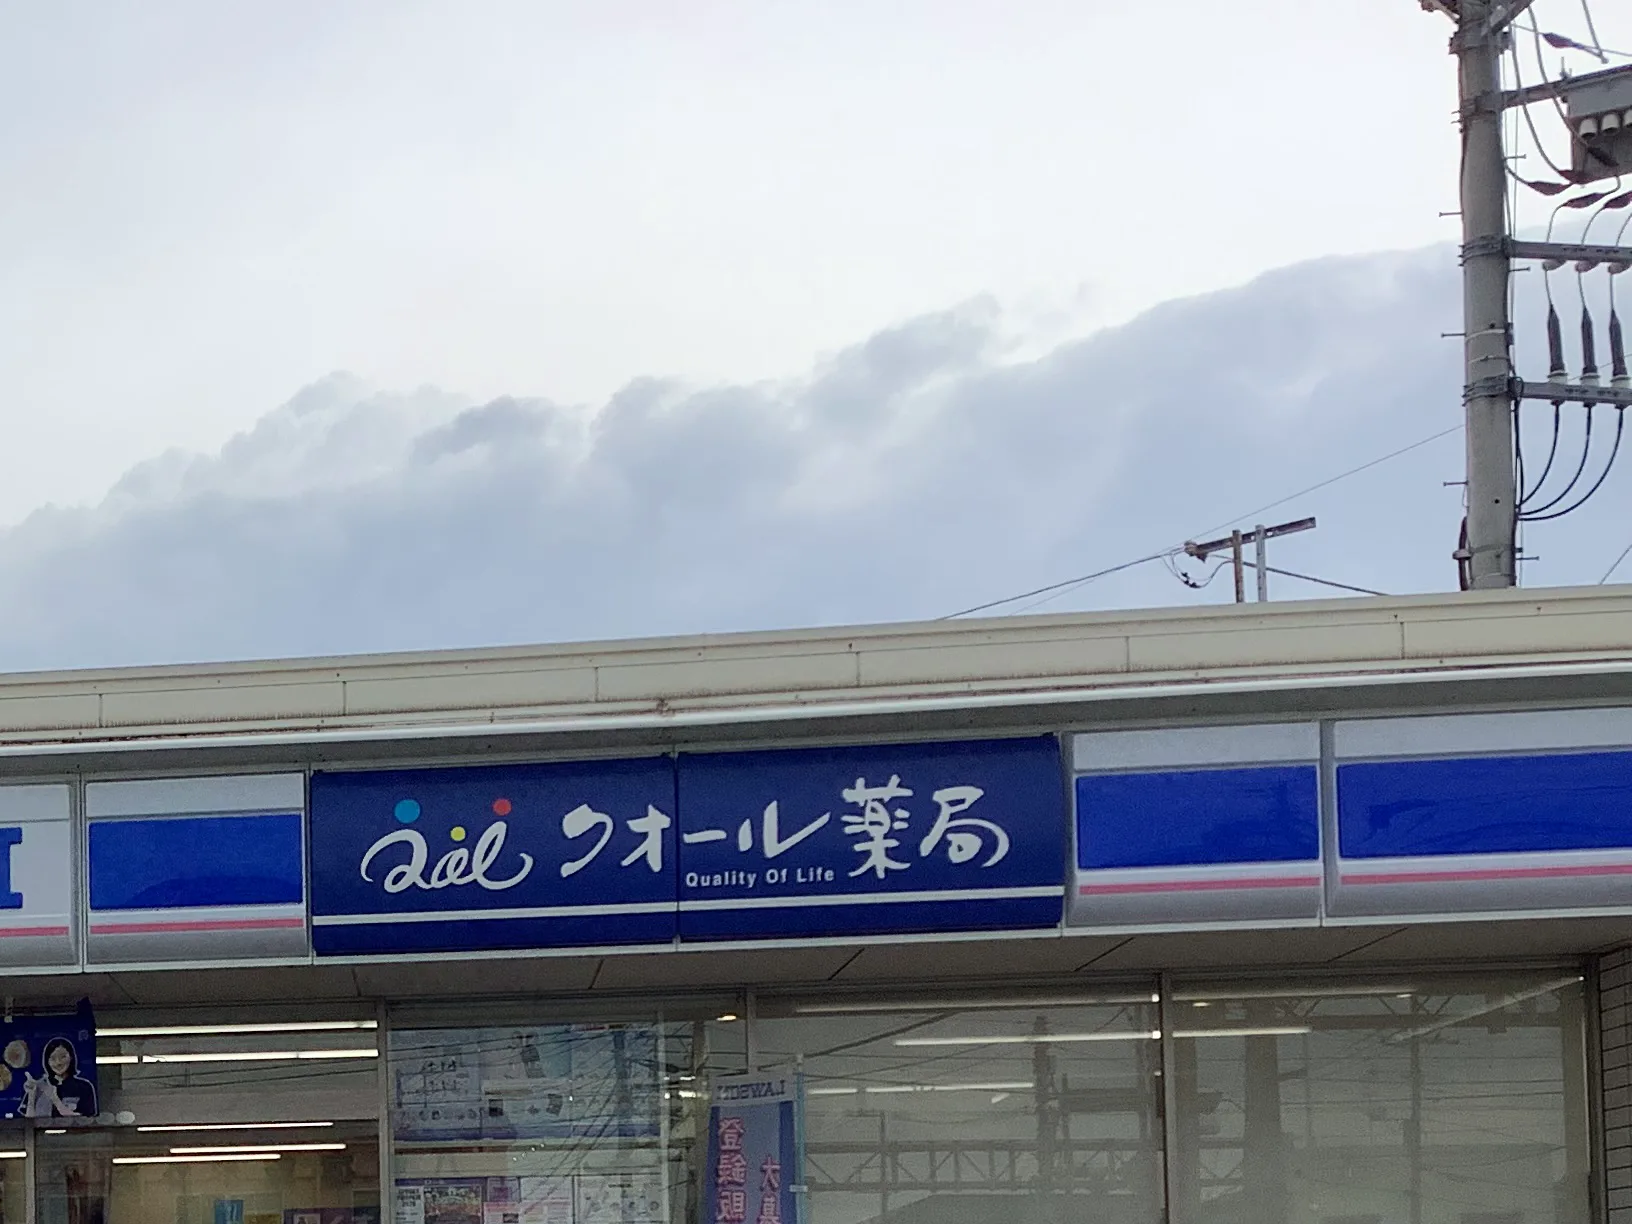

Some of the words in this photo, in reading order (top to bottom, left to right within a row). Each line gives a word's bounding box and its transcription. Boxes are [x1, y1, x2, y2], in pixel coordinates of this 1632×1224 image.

[561, 774, 1010, 880] クオール薬局
[685, 870, 757, 889] Quality
[765, 868, 789, 886] Of
[796, 865, 835, 884] Life
